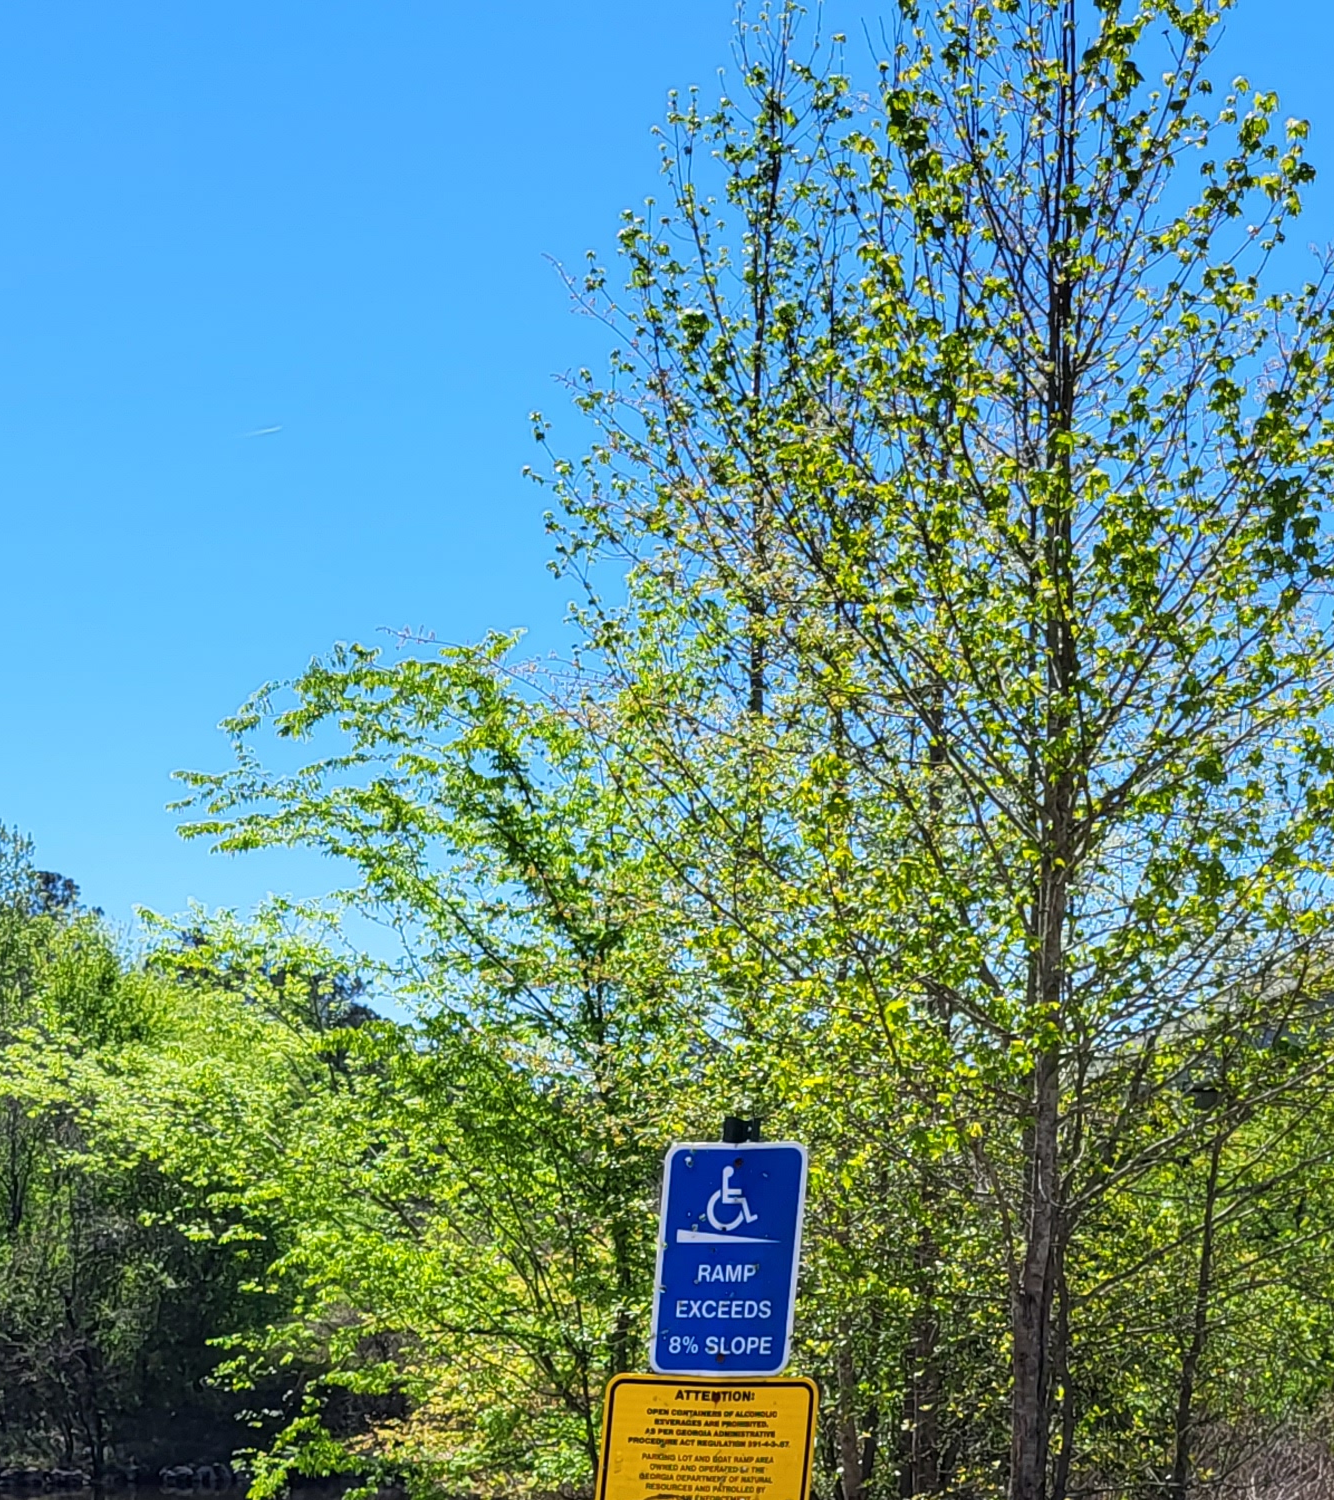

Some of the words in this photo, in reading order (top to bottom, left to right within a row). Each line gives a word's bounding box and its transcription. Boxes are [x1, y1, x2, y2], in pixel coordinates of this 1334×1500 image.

[697, 1264, 757, 1283] RAMP
[675, 1300, 772, 1319] EXCEEDS
[668, 1335, 699, 1354] 8%
[704, 1336, 773, 1355] SLOPE
[639, 1472, 674, 1480] GEORGIA
[741, 1477, 773, 1485] NATURAL
[645, 1482, 693, 1492] RESOURCES
